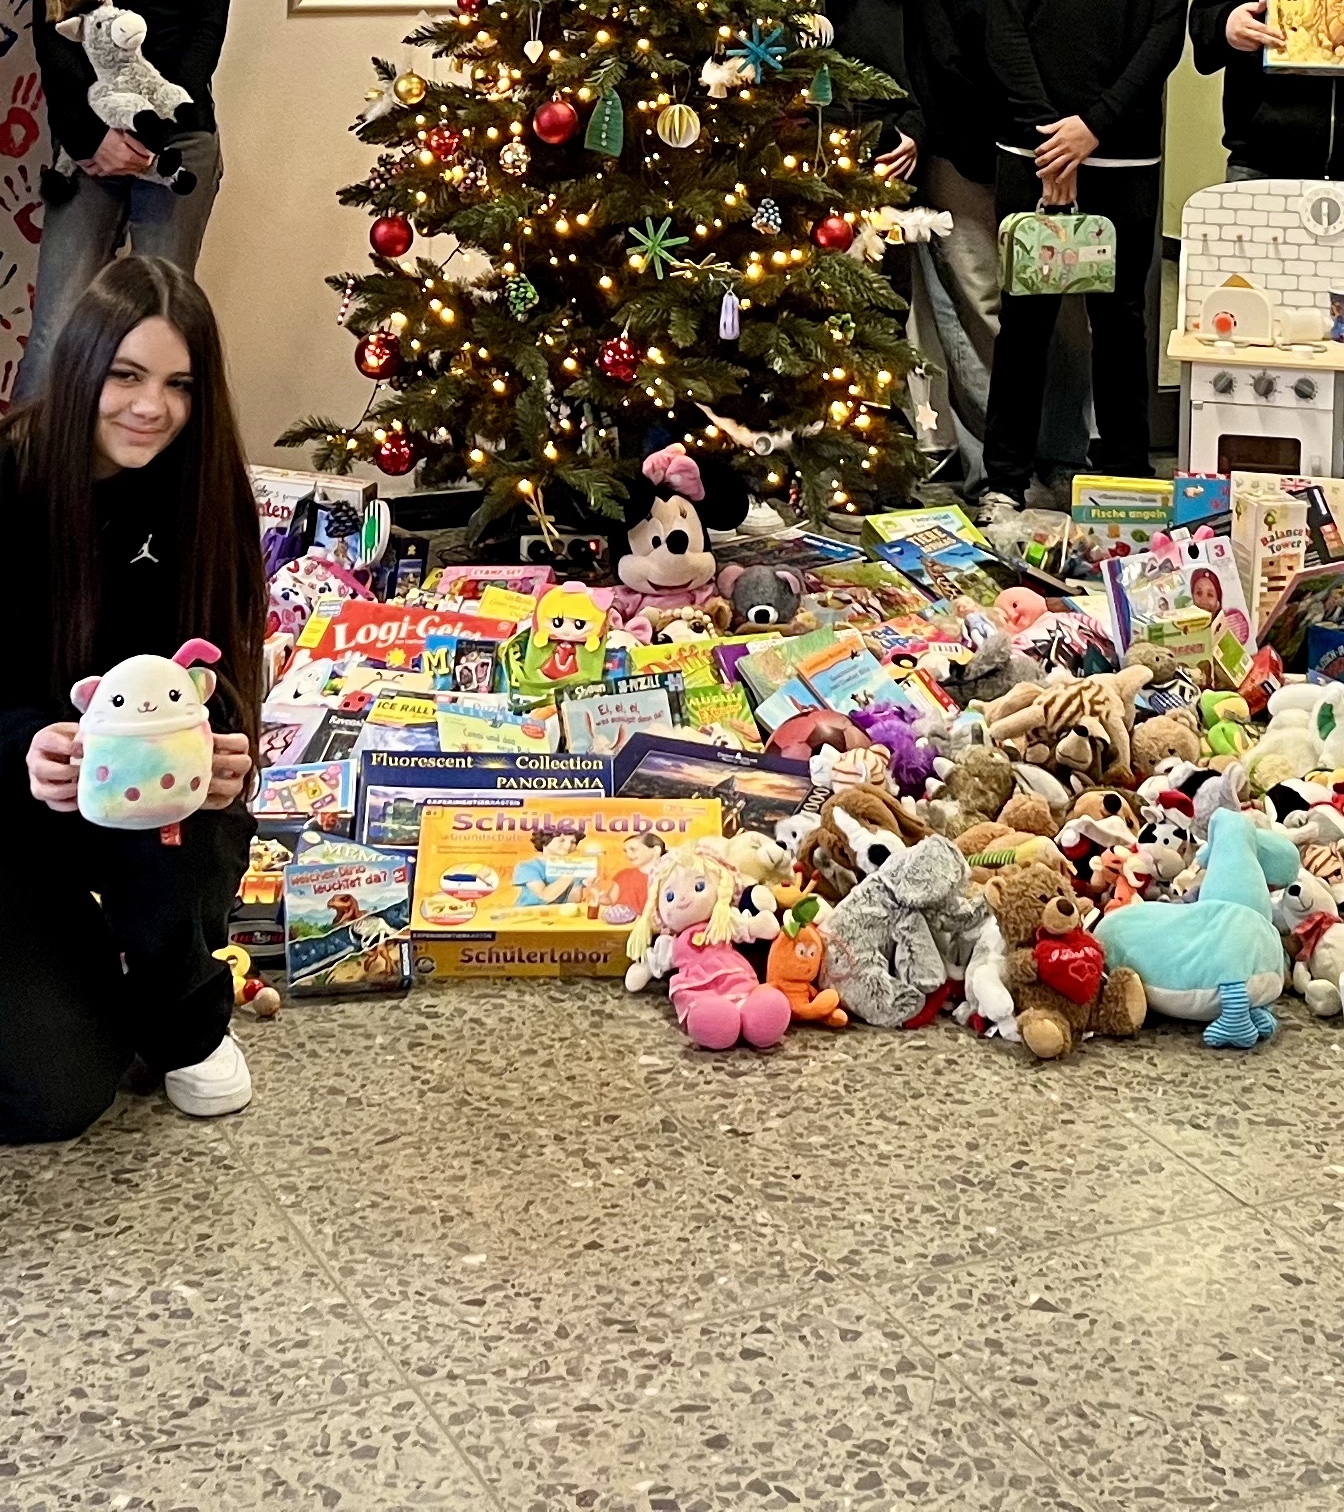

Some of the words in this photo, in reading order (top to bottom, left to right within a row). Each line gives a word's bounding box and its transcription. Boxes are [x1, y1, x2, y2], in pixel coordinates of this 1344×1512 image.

[1090, 509, 1126, 520] Fische
[1128, 508, 1167, 521] angeln
[1260, 527, 1304, 546] Balance
[1267, 539, 1302, 555] Tower
[377, 701, 398, 711] ICE
[400, 702, 438, 716] RALLY
[370, 752, 474, 769] Fluorescent
[515, 754, 605, 772] Collection
[496, 775, 605, 790] PANORAMA
[451, 810, 693, 834] Schülerlabor
[459, 945, 612, 965] Schülerlabor
